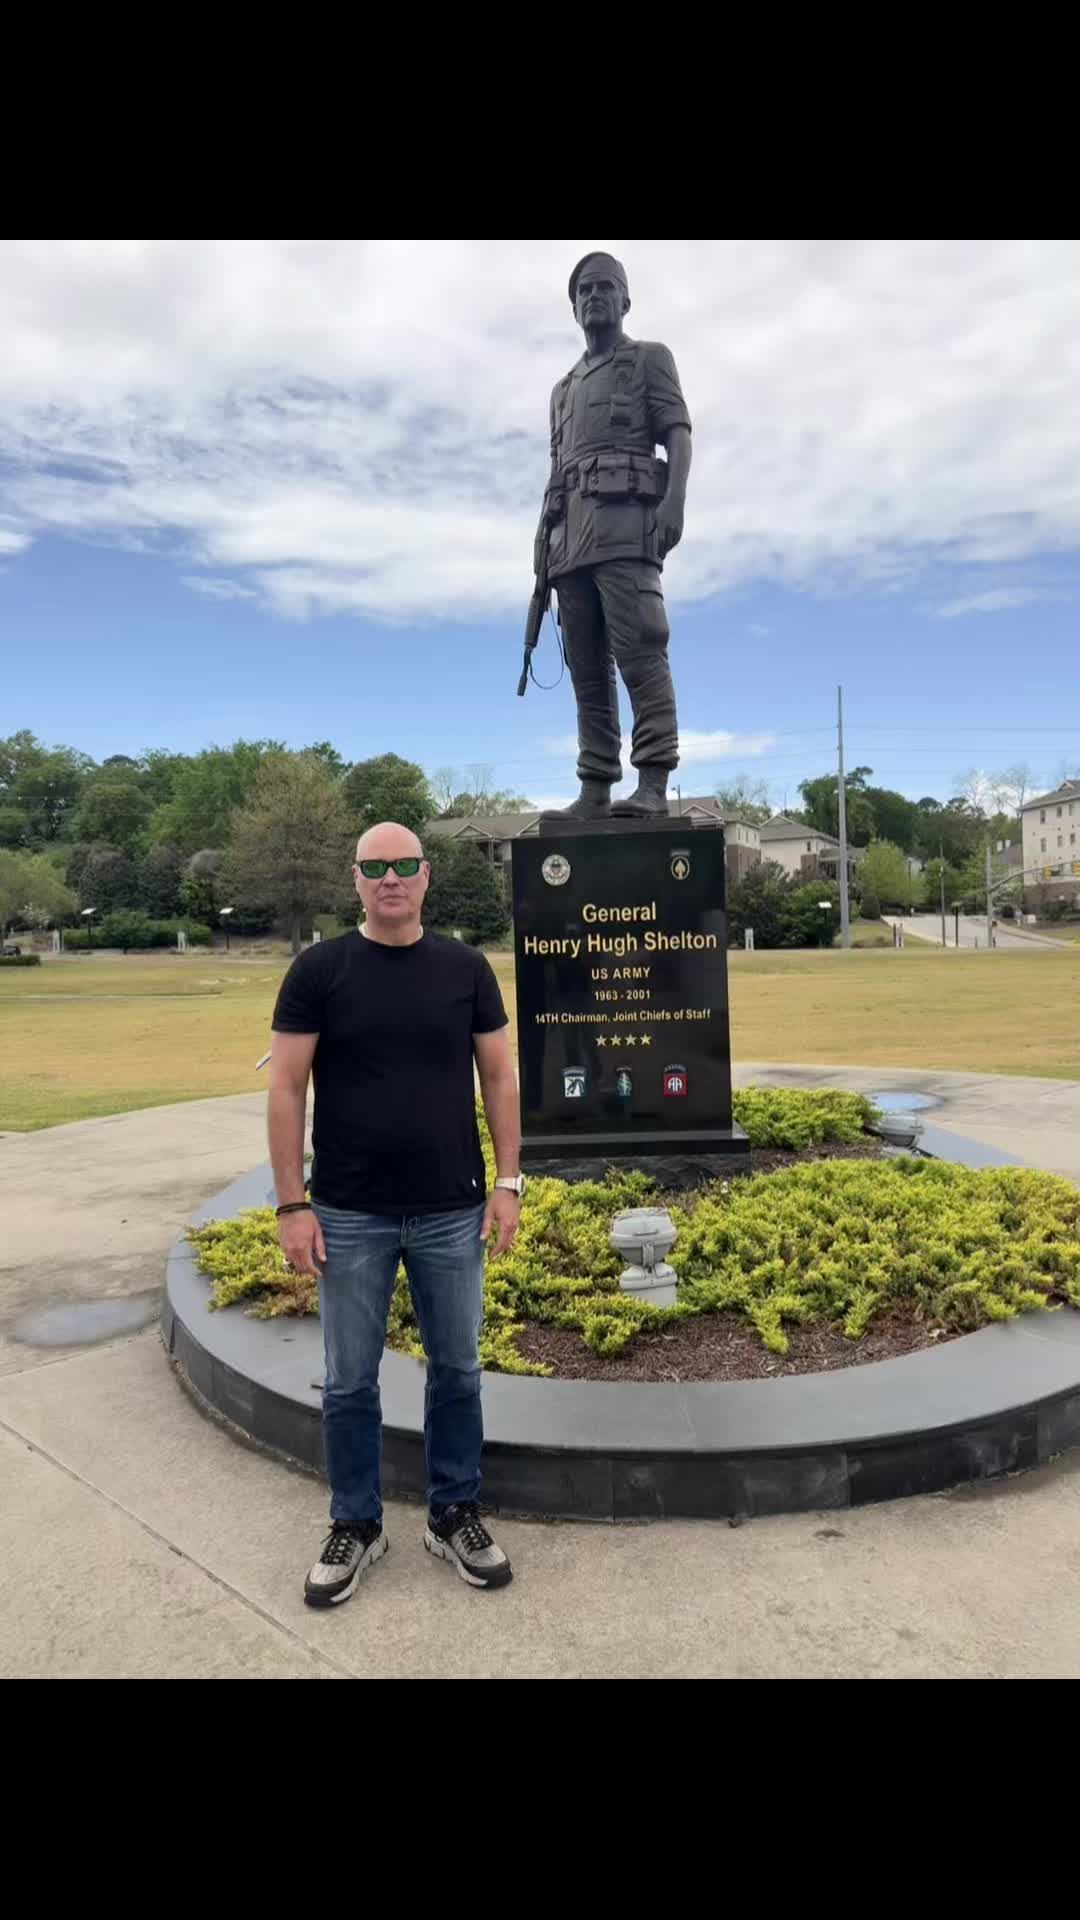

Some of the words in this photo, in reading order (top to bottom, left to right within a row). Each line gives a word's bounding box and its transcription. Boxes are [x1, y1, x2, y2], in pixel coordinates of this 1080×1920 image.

[583, 902, 656, 922] General
[524, 936, 581, 957] Henry
[587, 933, 637, 956] Hugh
[644, 931, 717, 950] Shelton
[592, 968, 608, 980] US
[613, 967, 651, 979] ARMY
[594, 991, 618, 1001] 1963
[627, 990, 651, 1000] 2001
[535, 1013, 559, 1024] 14TH
[561, 1011, 610, 1024] Chairman,
[613, 1010, 637, 1022] Joint
[640, 1009, 671, 1021] Chiefs
[674, 1009, 684, 1020] of
[686, 1008, 711, 1020] Staff
[668, 1077, 683, 1092] AA
